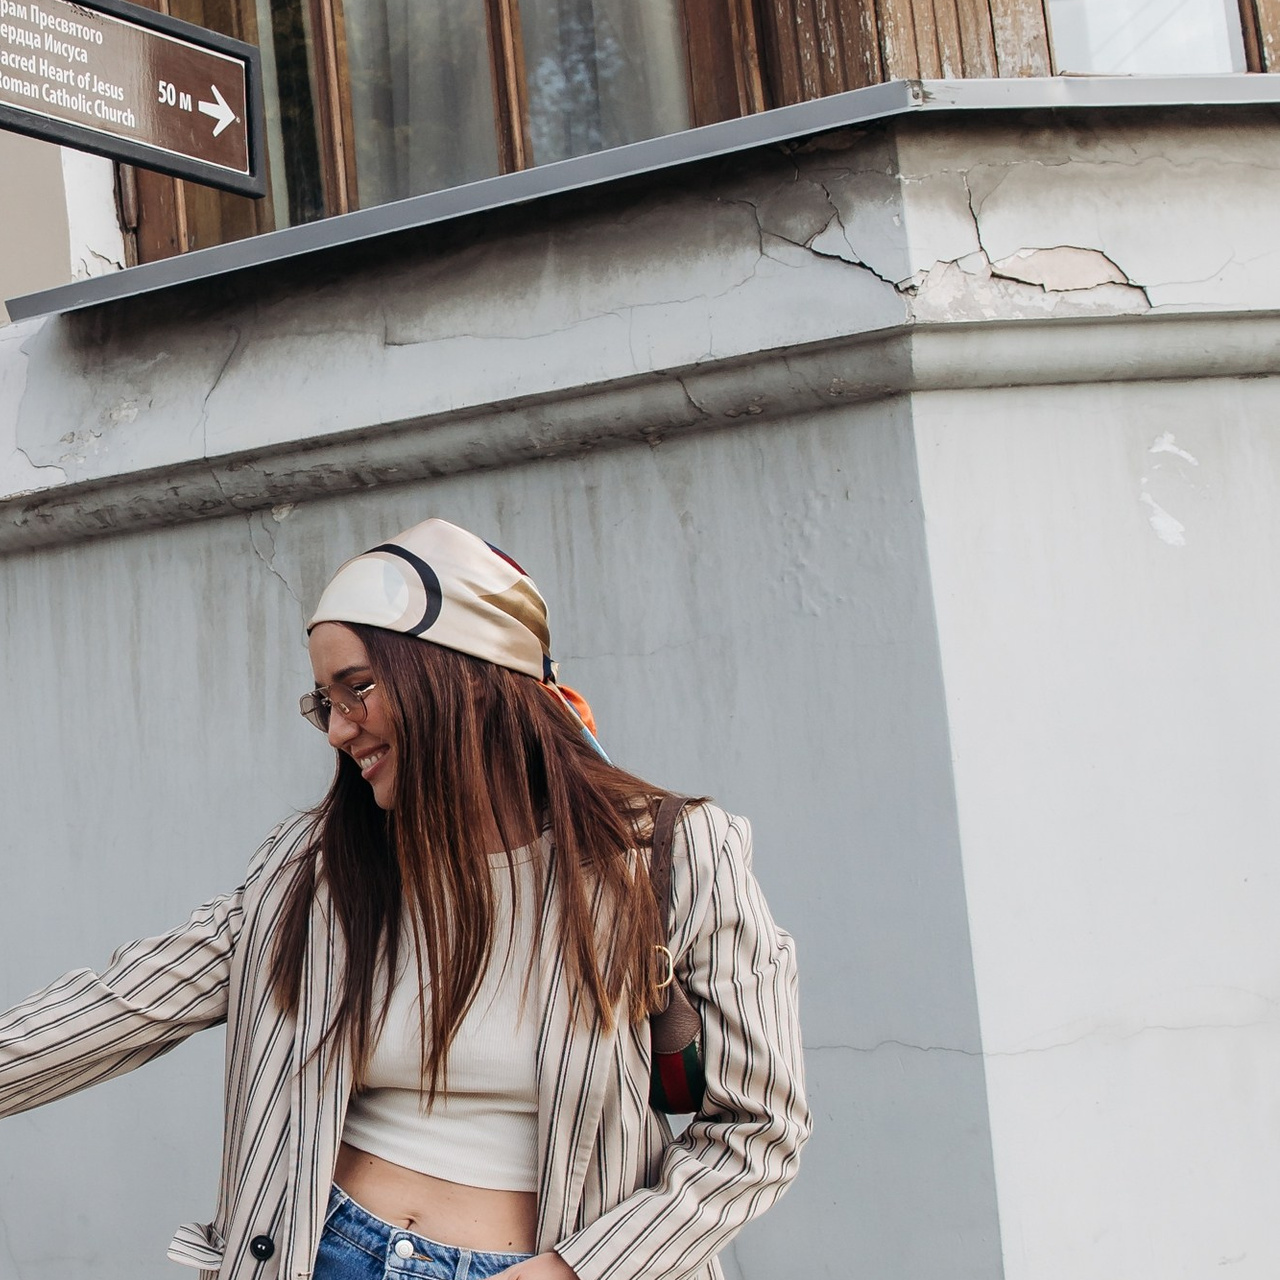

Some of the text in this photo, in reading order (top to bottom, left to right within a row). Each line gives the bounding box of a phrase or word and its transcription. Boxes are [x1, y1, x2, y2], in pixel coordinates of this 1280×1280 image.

[31, 4, 103, 45] Пресвятого
[44, 32, 88, 63] Иисуса
[39, 58, 75, 86] Heart
[77, 72, 90, 90] of
[92, 75, 124, 101] Jesus
[158, 80, 192, 112] 50 м
[42, 83, 92, 115] Catholic
[94, 99, 135, 128] Church
